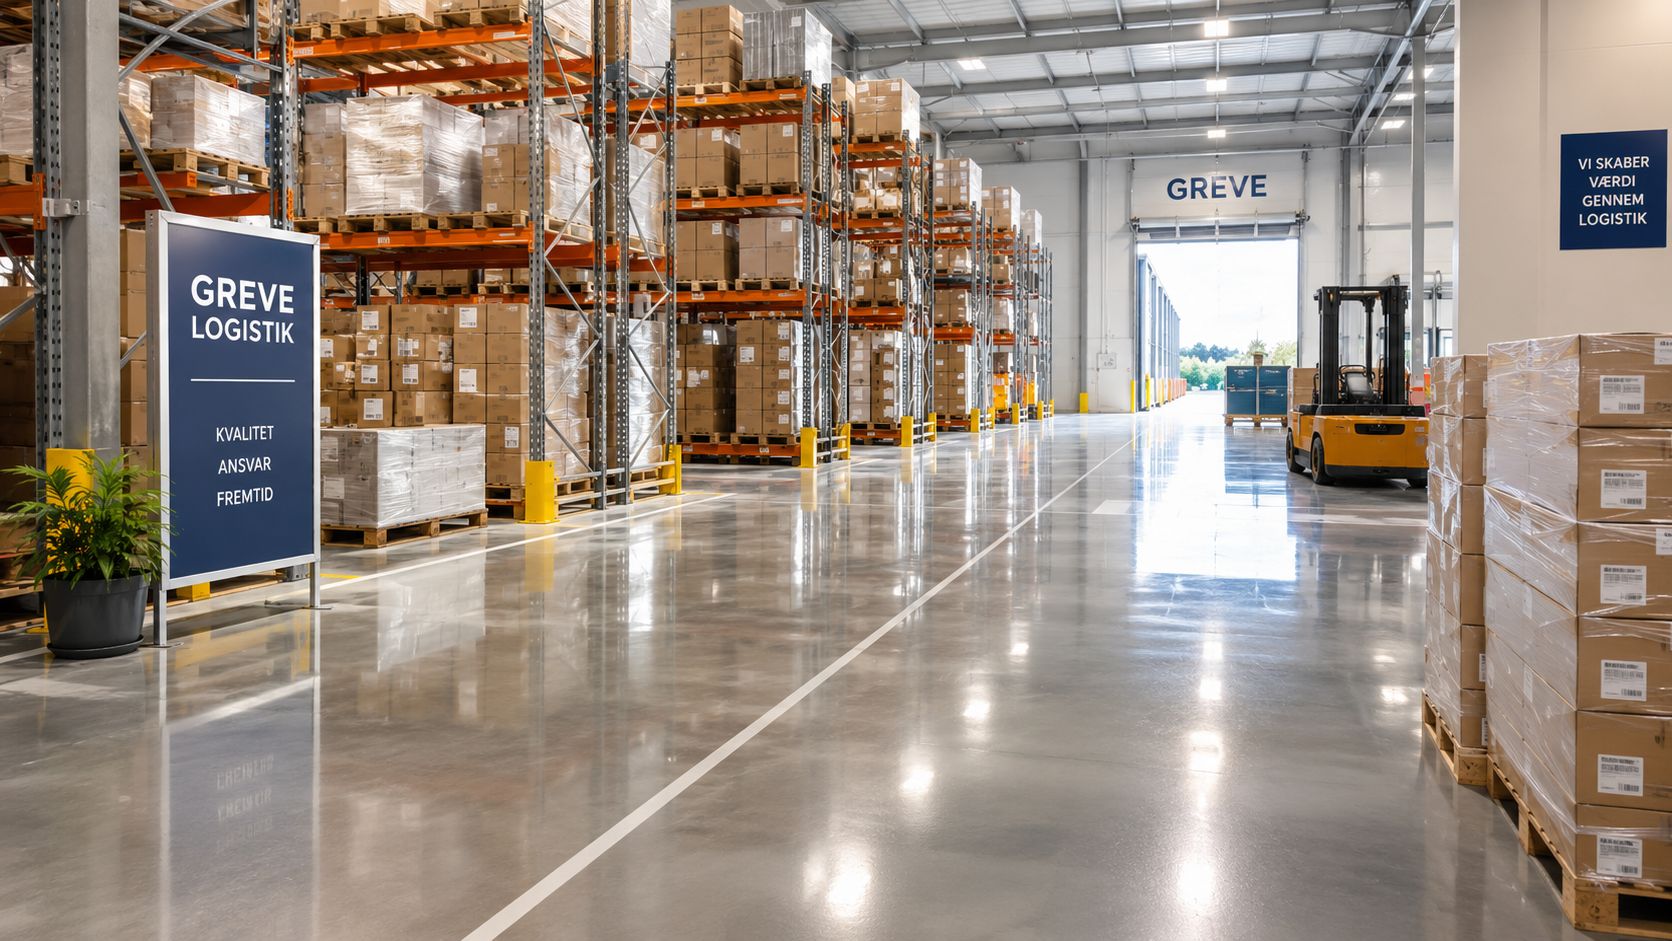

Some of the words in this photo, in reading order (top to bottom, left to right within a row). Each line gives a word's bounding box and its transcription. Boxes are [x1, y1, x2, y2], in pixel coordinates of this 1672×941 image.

[1578, 158, 1592, 170] VI
[1595, 155, 1650, 170] SKABER
[1166, 174, 1268, 201] GREVE
[1589, 175, 1636, 188] VÆRDI
[1582, 193, 1644, 207] GENNEM
[1579, 212, 1647, 226] LOGISTIK
[190, 274, 295, 314] GREVE
[191, 315, 295, 344] LOGISTIK
[216, 425, 275, 442] KVALITET
[217, 456, 272, 475] ANSVAR
[217, 486, 274, 507] FREMTID
